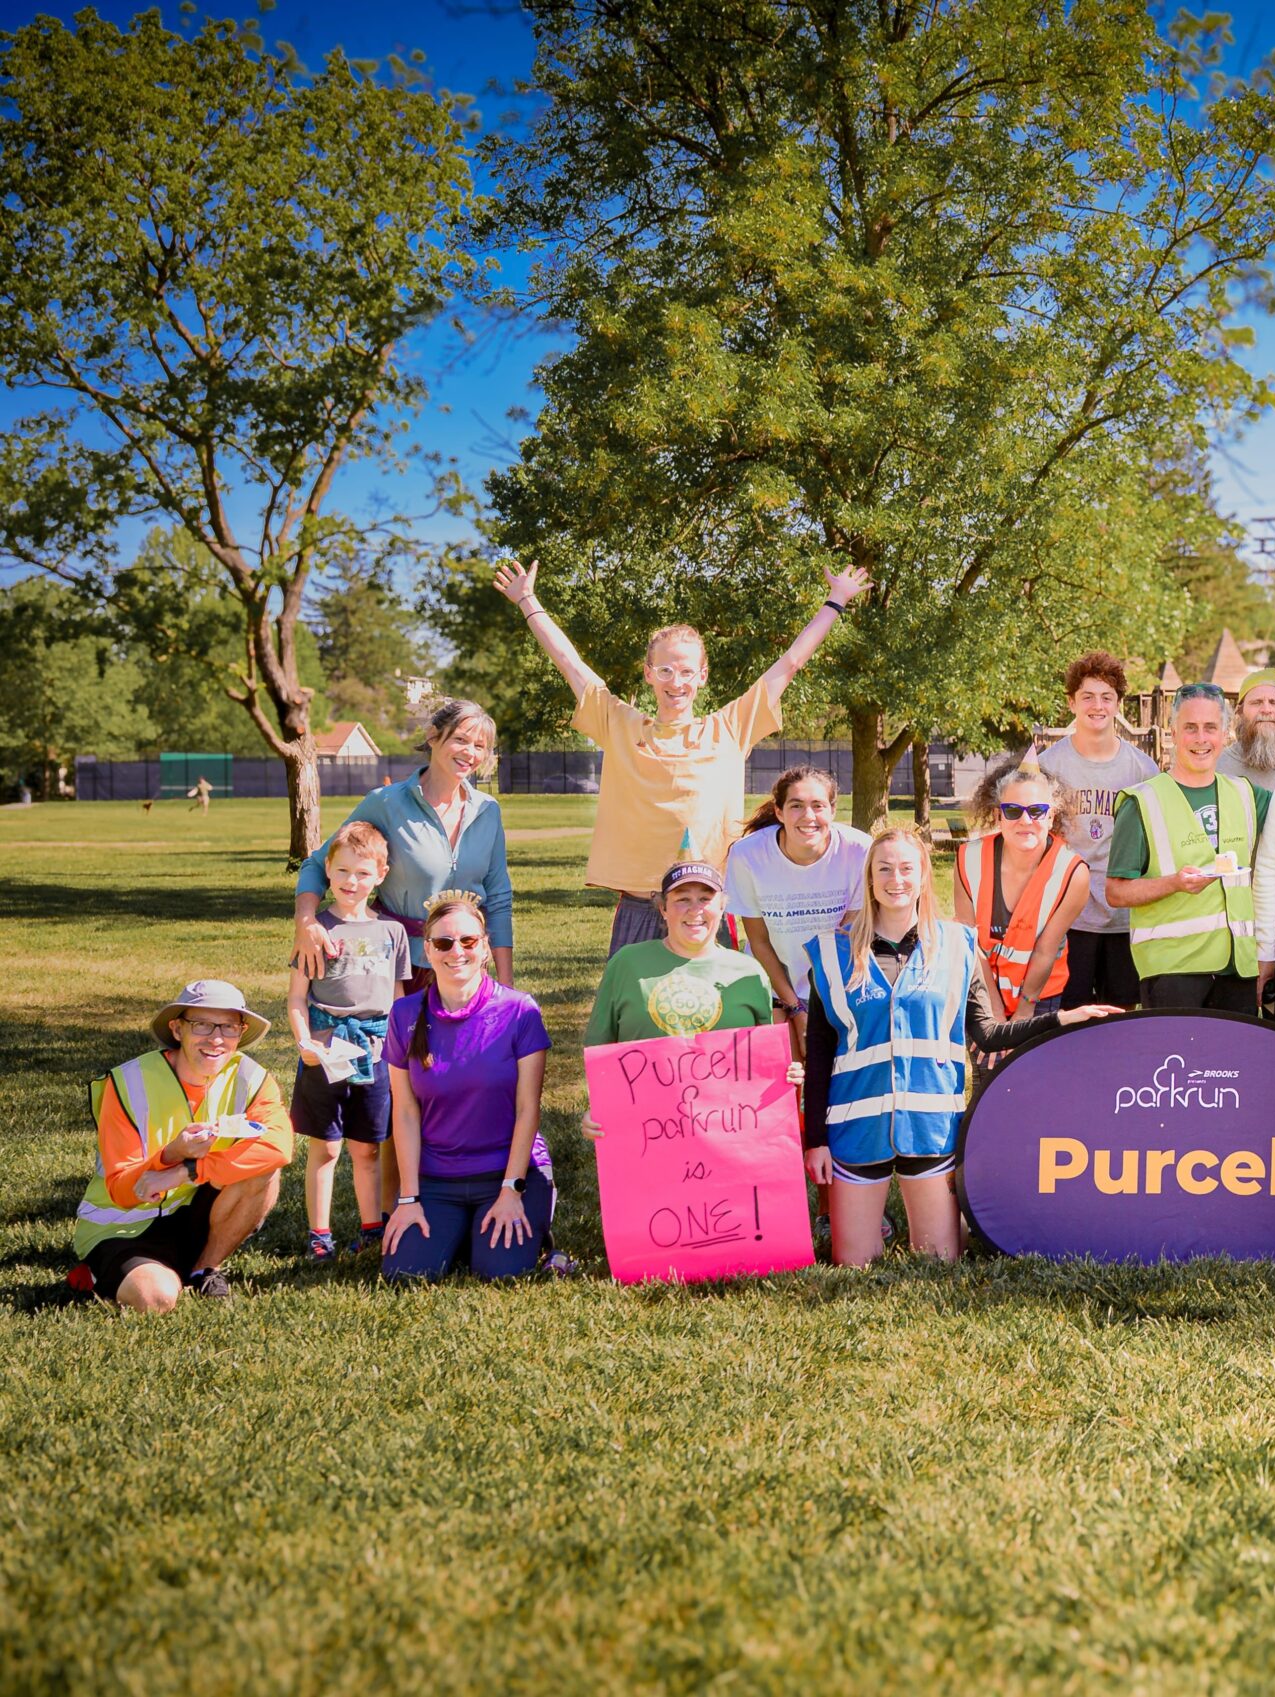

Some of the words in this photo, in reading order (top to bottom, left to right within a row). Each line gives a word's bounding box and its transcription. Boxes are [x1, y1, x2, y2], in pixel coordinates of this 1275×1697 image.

[617, 1030, 752, 1105] Purcell
[1204, 1070, 1240, 1078] BROOKS
[1114, 1070, 1240, 1114] parkrun
[641, 1093, 758, 1158] parkrun
[682, 1161, 712, 1183] is
